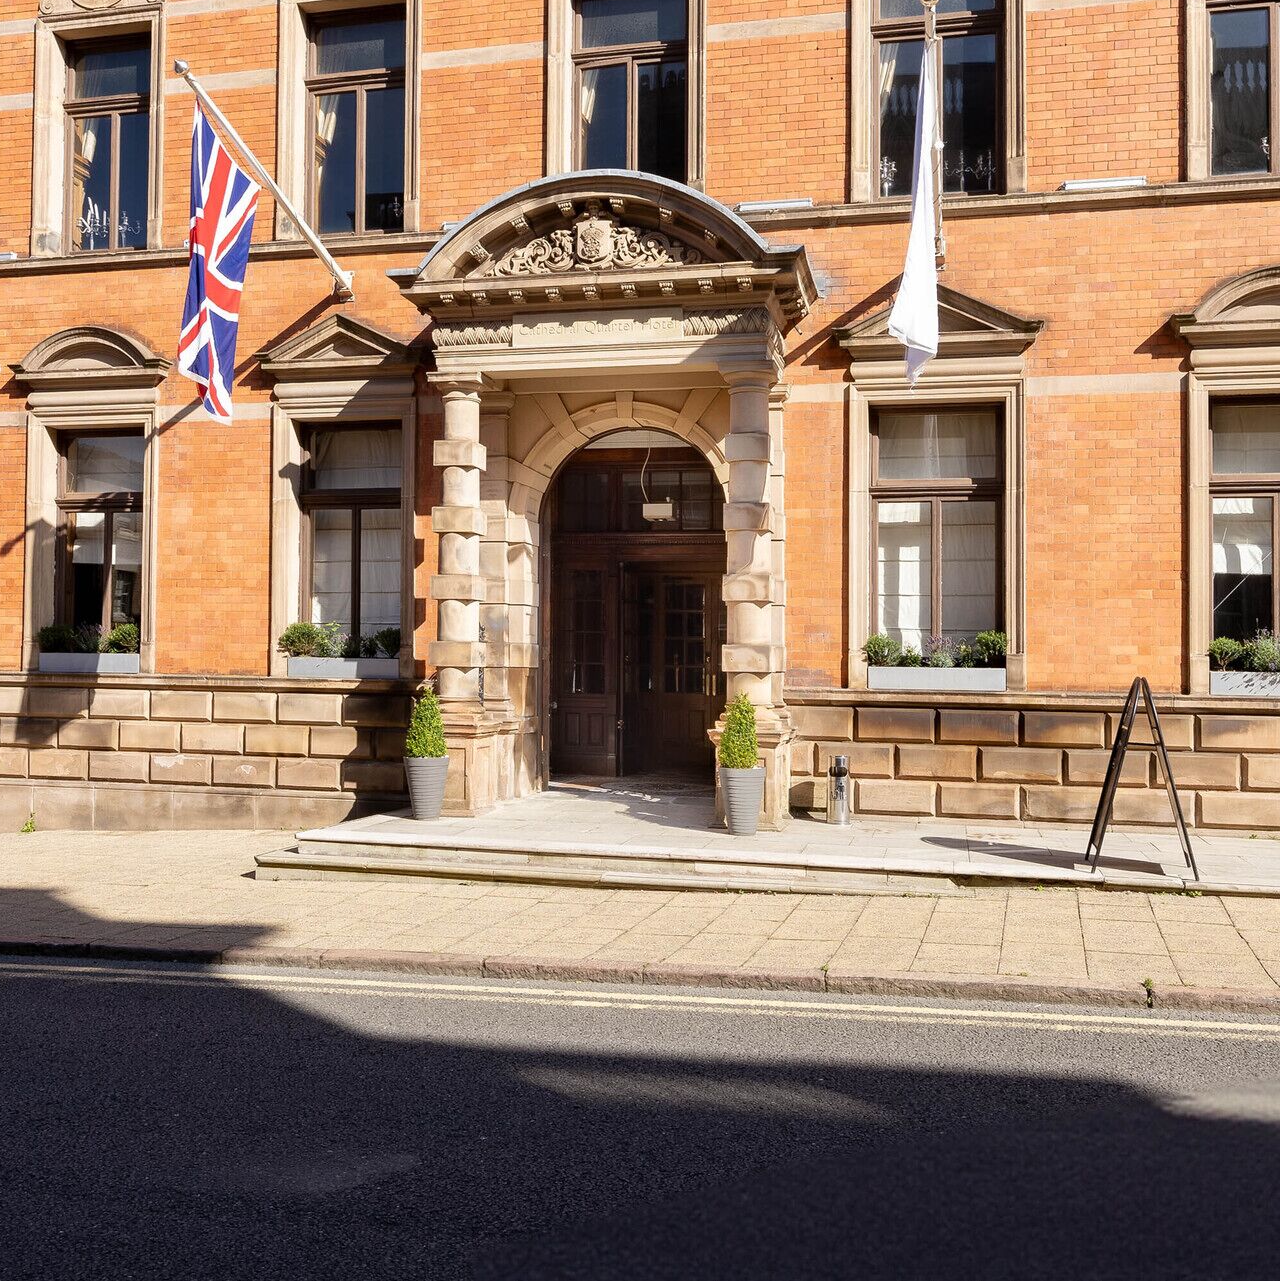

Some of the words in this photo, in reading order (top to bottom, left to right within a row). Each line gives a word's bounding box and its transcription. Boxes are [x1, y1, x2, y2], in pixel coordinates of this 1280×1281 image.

[519, 323, 578, 336] Cathedral
[584, 321, 635, 335] Quarter
[641, 318, 677, 331] Hotel
